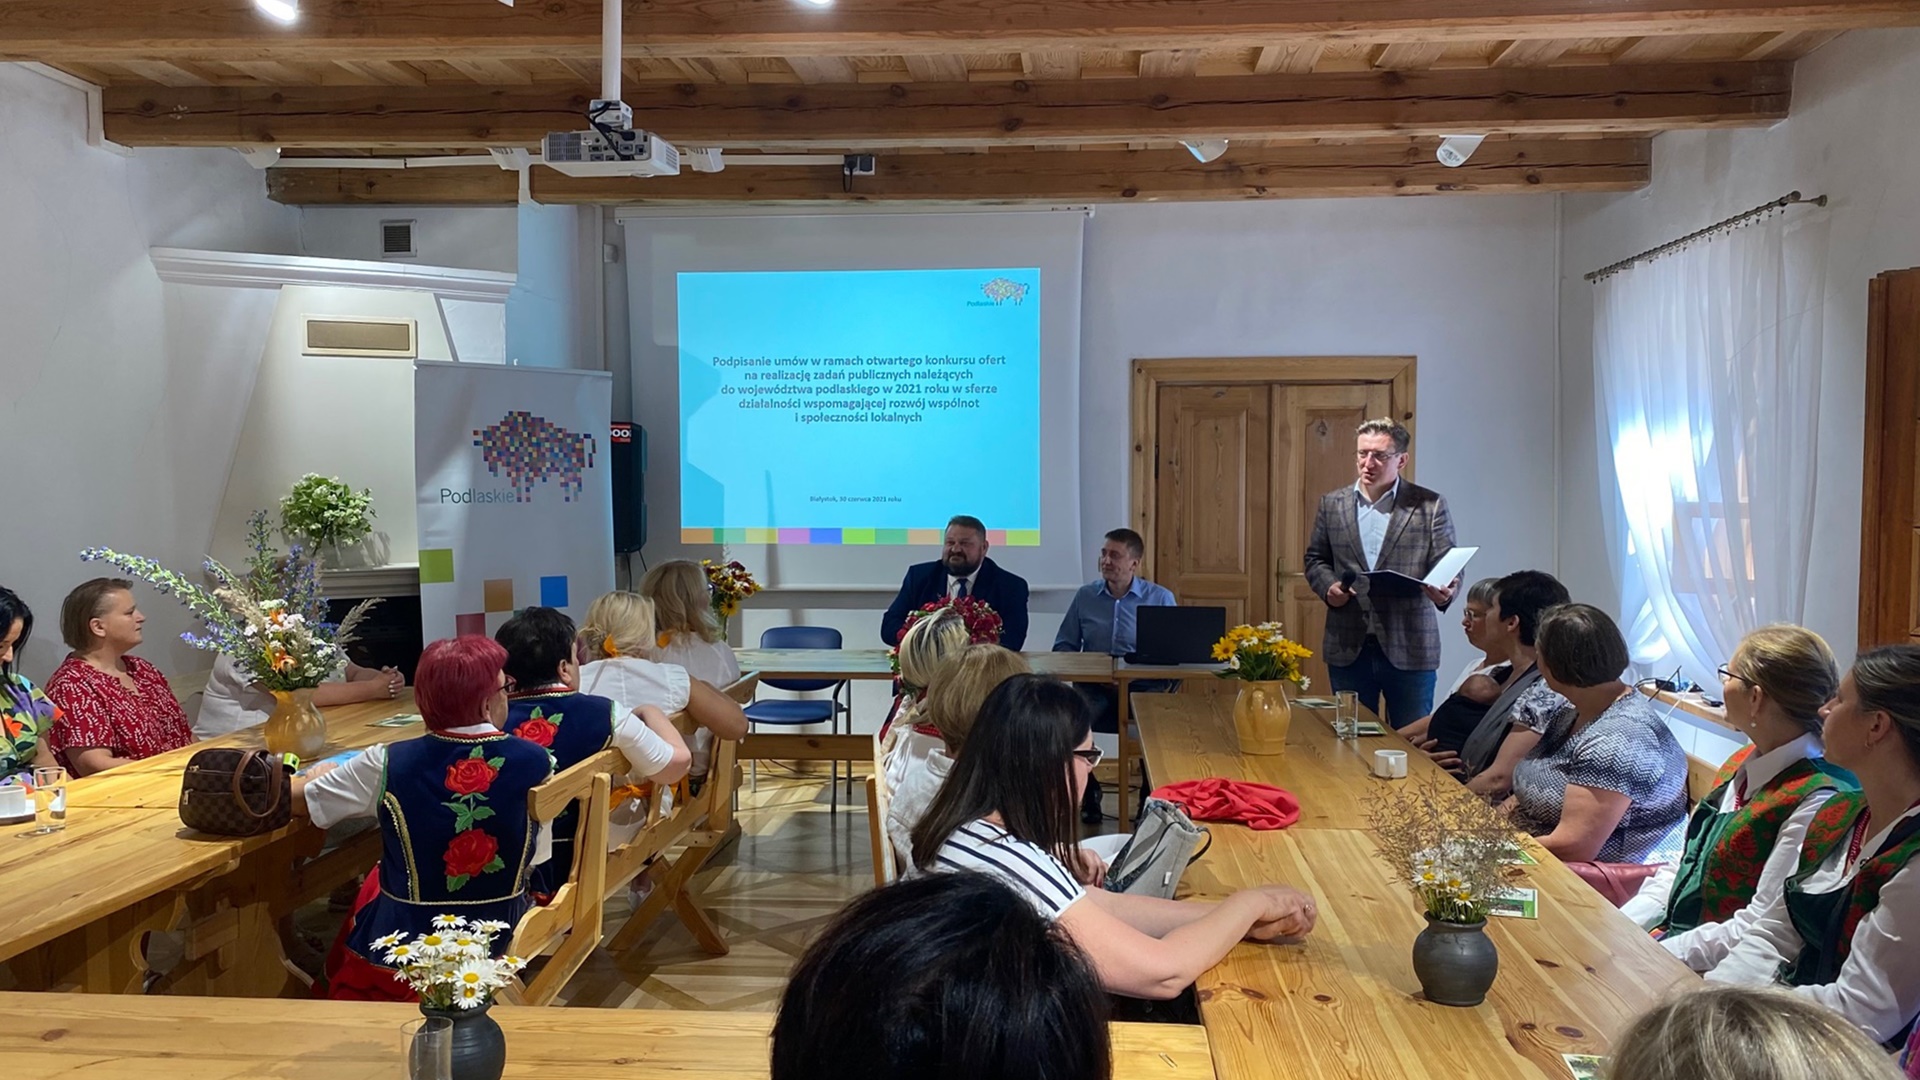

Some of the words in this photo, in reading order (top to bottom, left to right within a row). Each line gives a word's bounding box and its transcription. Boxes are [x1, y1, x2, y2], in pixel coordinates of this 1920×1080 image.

[712, 356, 772, 369] Podpisanie
[774, 355, 808, 366] umów
[811, 358, 821, 366] w
[823, 355, 863, 366] ramach
[866, 355, 923, 368] otwartego
[925, 355, 976, 365] konkursu
[978, 354, 1006, 365] ofert
[744, 371, 758, 380] na
[760, 369, 811, 382] realizację
[813, 369, 846, 380] zadań
[848, 369, 911, 382] publicznych
[914, 368, 973, 382] należących
[721, 384, 735, 394] do
[738, 384, 813, 397] województwa
[815, 383, 880, 396] podlaskiego
[882, 385, 893, 394] w
[895, 383, 922, 394] 2021
[924, 383, 949, 394] roku
[952, 385, 963, 394] w
[965, 383, 998, 394] sferze
[738, 398, 801, 409] działalności
[803, 398, 886, 411] wspomagającej
[889, 398, 925, 410] rozwój
[928, 397, 980, 410] wspólnot
[801, 412, 868, 424] społeczności
[871, 411, 922, 424] lokalnych
[440, 488, 515, 504] Podlaskie
